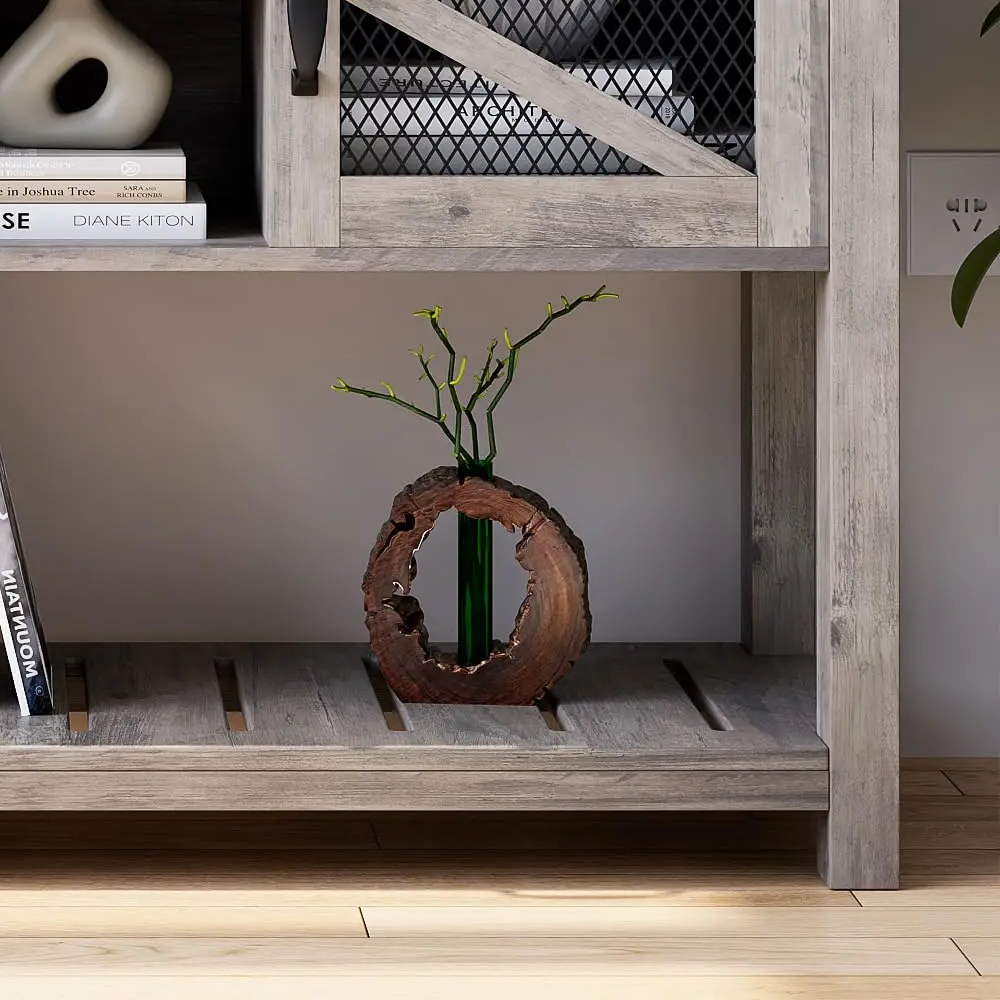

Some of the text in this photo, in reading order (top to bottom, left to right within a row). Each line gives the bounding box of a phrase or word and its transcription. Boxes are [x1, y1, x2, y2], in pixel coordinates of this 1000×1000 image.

[7, 187, 19, 197] in
[22, 187, 65, 197] Joshua
[68, 187, 96, 197] Tree
[73, 215, 194, 227] DIANE KITON
